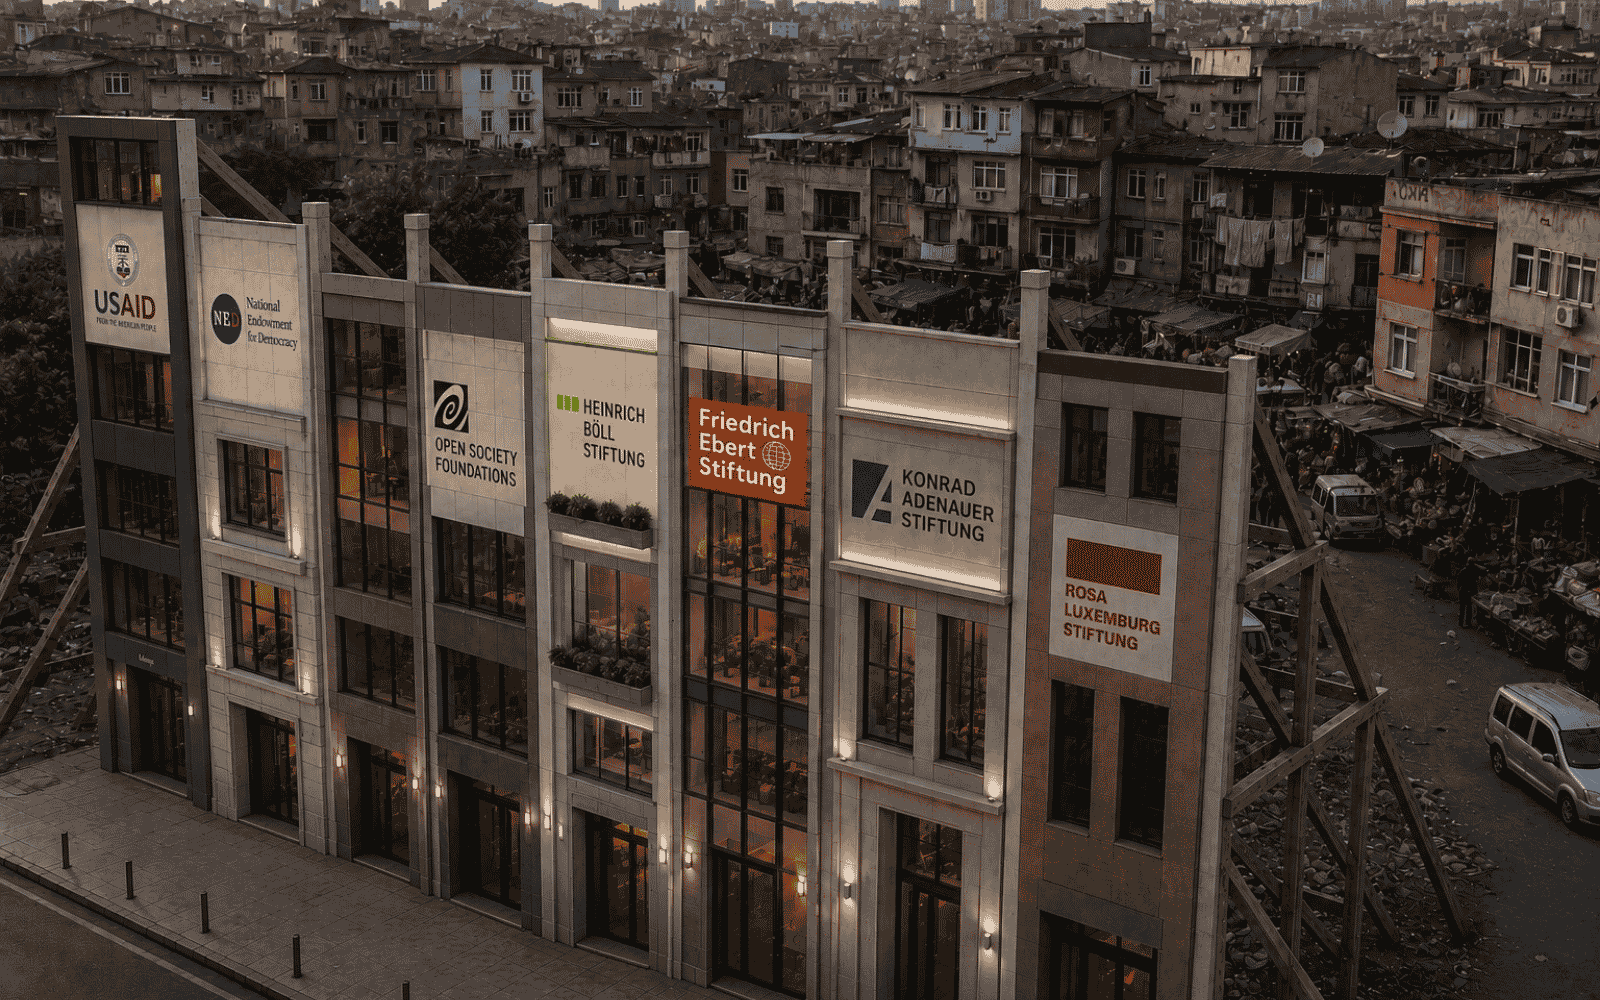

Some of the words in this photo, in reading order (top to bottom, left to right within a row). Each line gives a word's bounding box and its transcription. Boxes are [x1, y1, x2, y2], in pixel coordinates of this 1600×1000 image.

[95, 289, 156, 320] USAID
[246, 296, 280, 312] National
[213, 310, 240, 328] NED
[247, 314, 293, 331] Endowment
[247, 330, 257, 342] for
[257, 332, 297, 351] Democracy
[583, 398, 645, 424] HEINRICH
[699, 407, 794, 442] Friedrich
[583, 419, 616, 442] BÖLL
[435, 436, 466, 456] OPEN
[469, 443, 517, 466] SOCIETY
[583, 442, 645, 468] STIFTUNG
[699, 432, 757, 460] Ebert
[435, 456, 517, 487] FOUNDATIONS
[699, 456, 786, 495] Stiftung
[902, 468, 976, 497] KONRAD
[902, 490, 995, 523] ADENAUER
[901, 511, 985, 543] STIFTUNG
[1065, 583, 1108, 605] ROSA
[1064, 602, 1161, 636] LUXEMBURG
[1063, 622, 1138, 651] STIFTUNG
